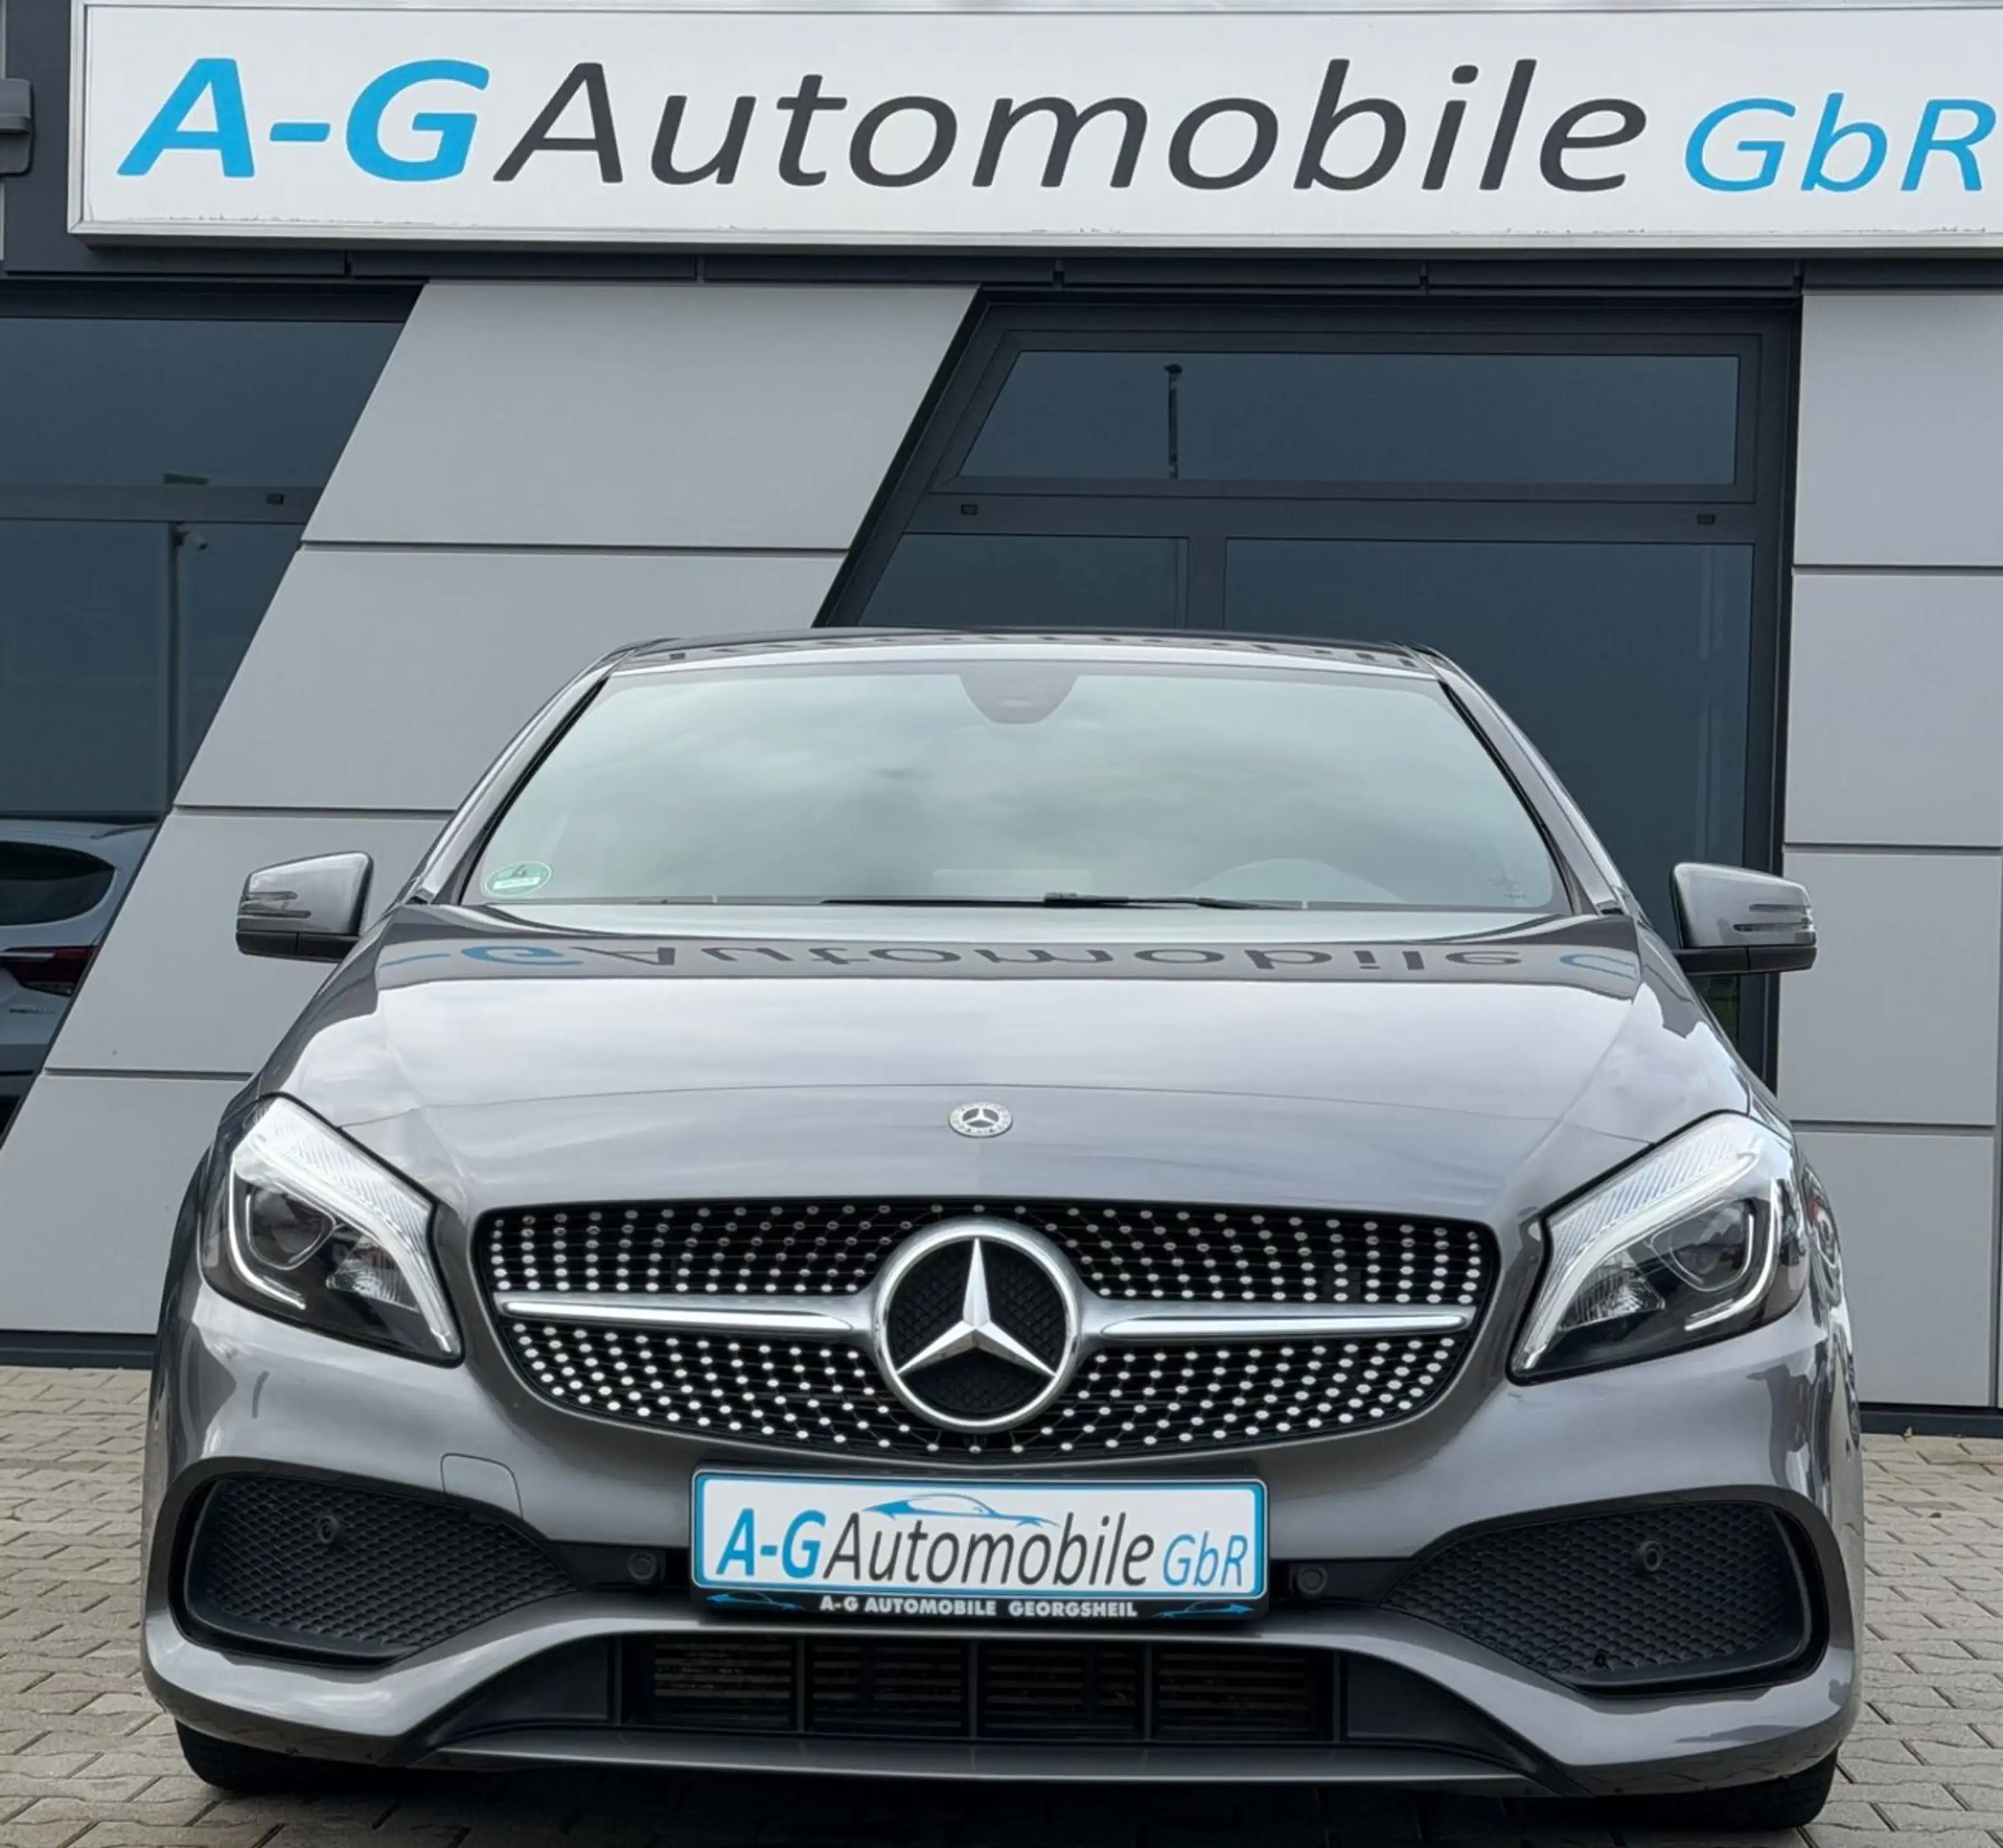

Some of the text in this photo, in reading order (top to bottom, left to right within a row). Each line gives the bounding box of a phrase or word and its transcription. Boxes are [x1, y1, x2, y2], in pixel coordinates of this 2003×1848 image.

[117, 56, 1997, 194] A-G Automobile GbR
[715, 1507, 1249, 1588] A-G Automobile GbR
[819, 1595, 1138, 1618] A-G AUTOMOBILE GEORGSHEIL
